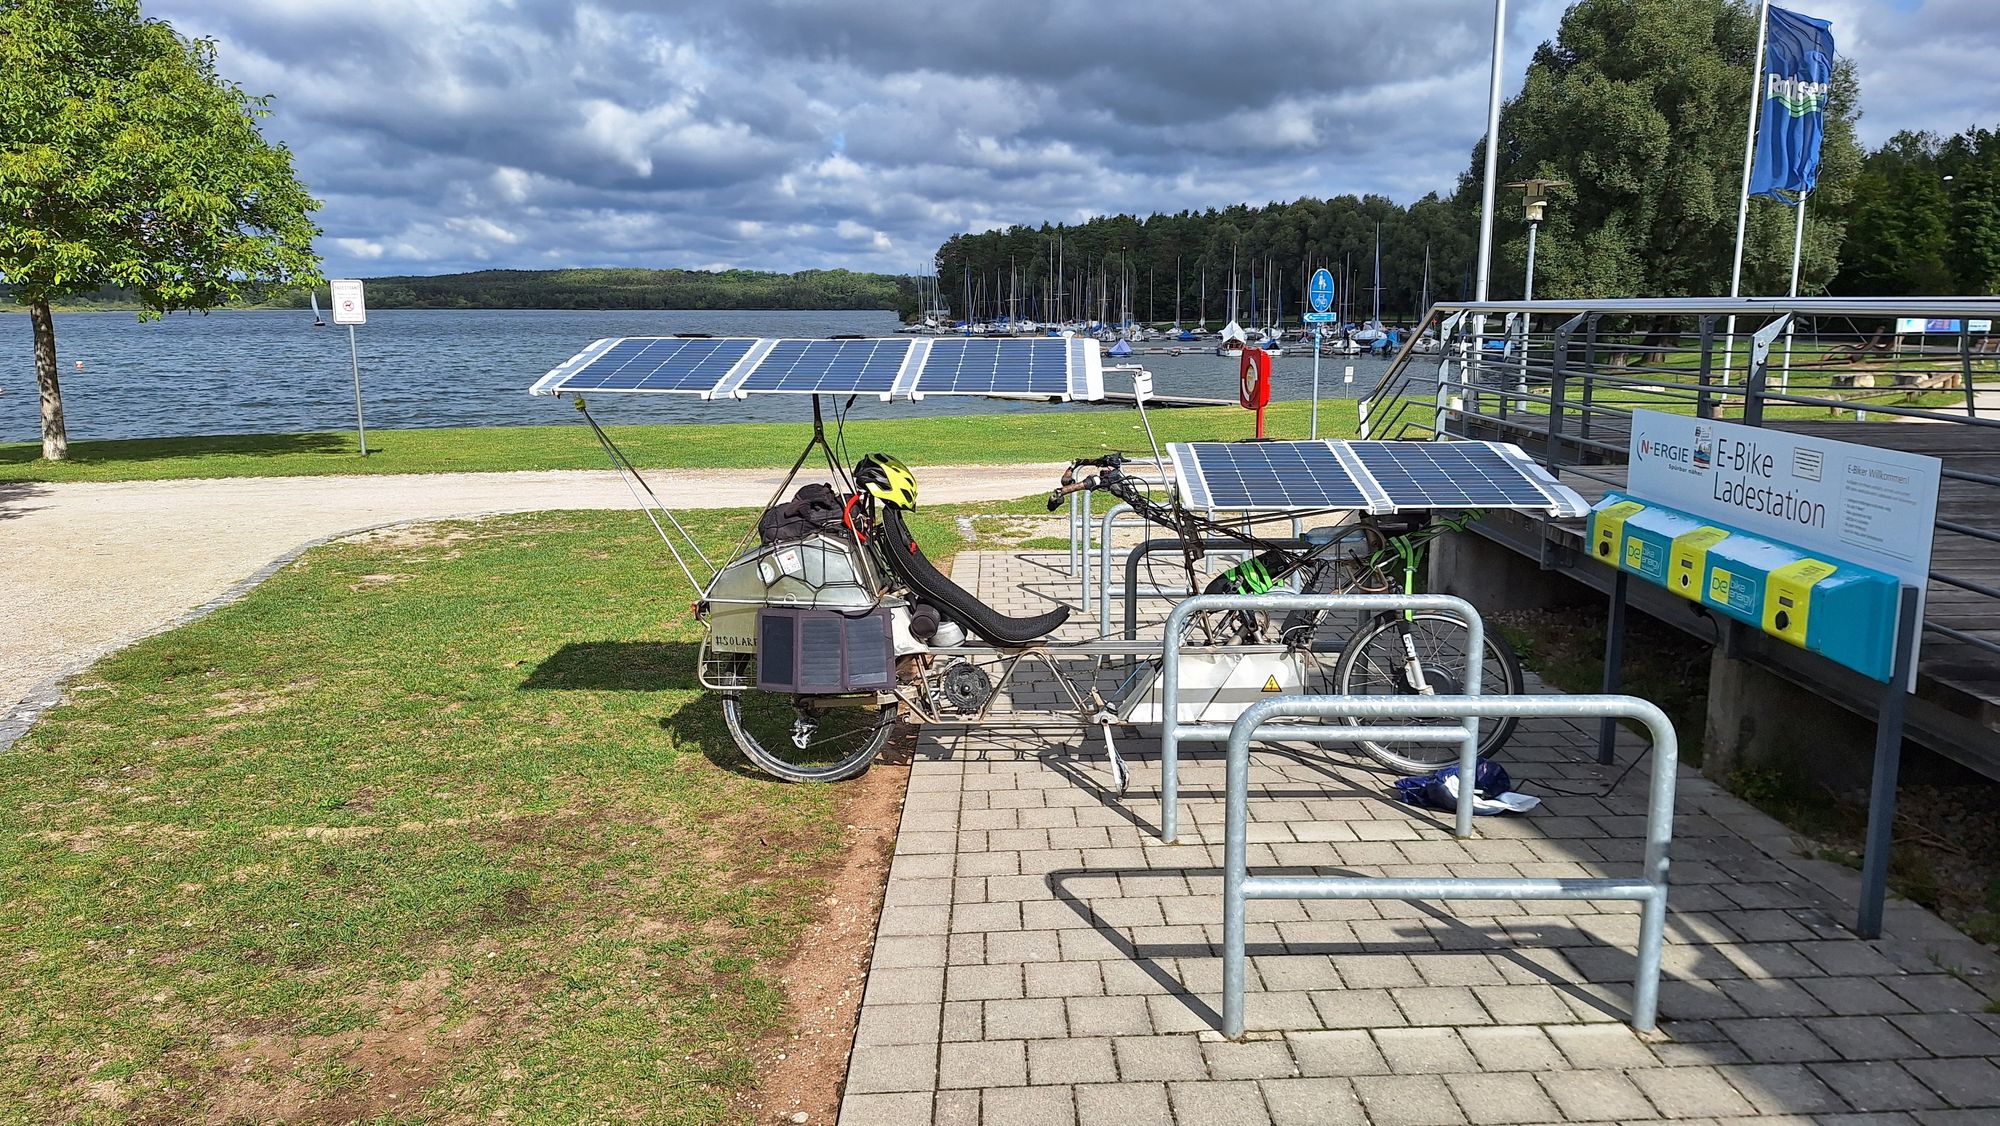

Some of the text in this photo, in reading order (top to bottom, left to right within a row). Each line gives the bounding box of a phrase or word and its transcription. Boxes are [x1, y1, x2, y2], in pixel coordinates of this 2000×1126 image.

[1641, 439, 1689, 463] N-ERGIE
[1717, 438, 1774, 478] E-Bike
[1847, 464, 1868, 477] E-Biker
[1714, 471, 1826, 529] Ladestation
[1729, 589, 1752, 607] energy
